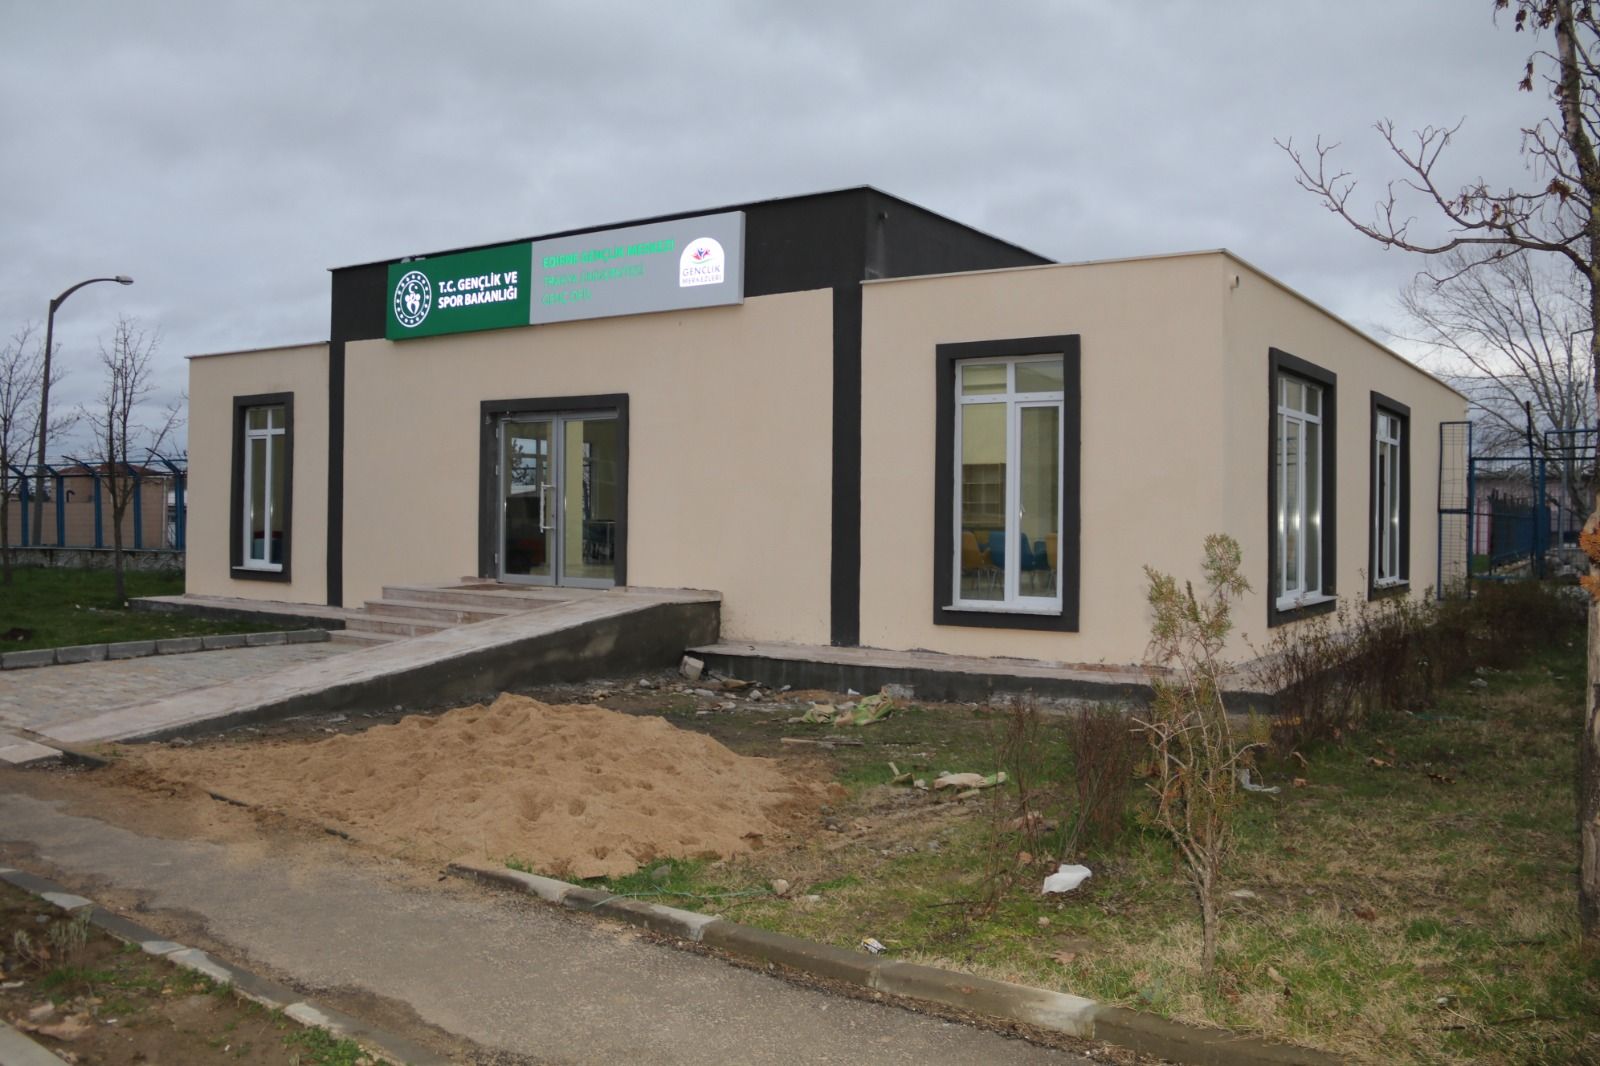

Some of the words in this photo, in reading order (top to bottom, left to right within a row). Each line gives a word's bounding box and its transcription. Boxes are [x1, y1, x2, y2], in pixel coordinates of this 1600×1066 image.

[438, 280, 457, 293] T.C.
[457, 271, 502, 291] GENÇLİK
[503, 271, 518, 285] VE
[438, 295, 463, 309] SPOR
[464, 286, 518, 306] BAKANLIĞI
